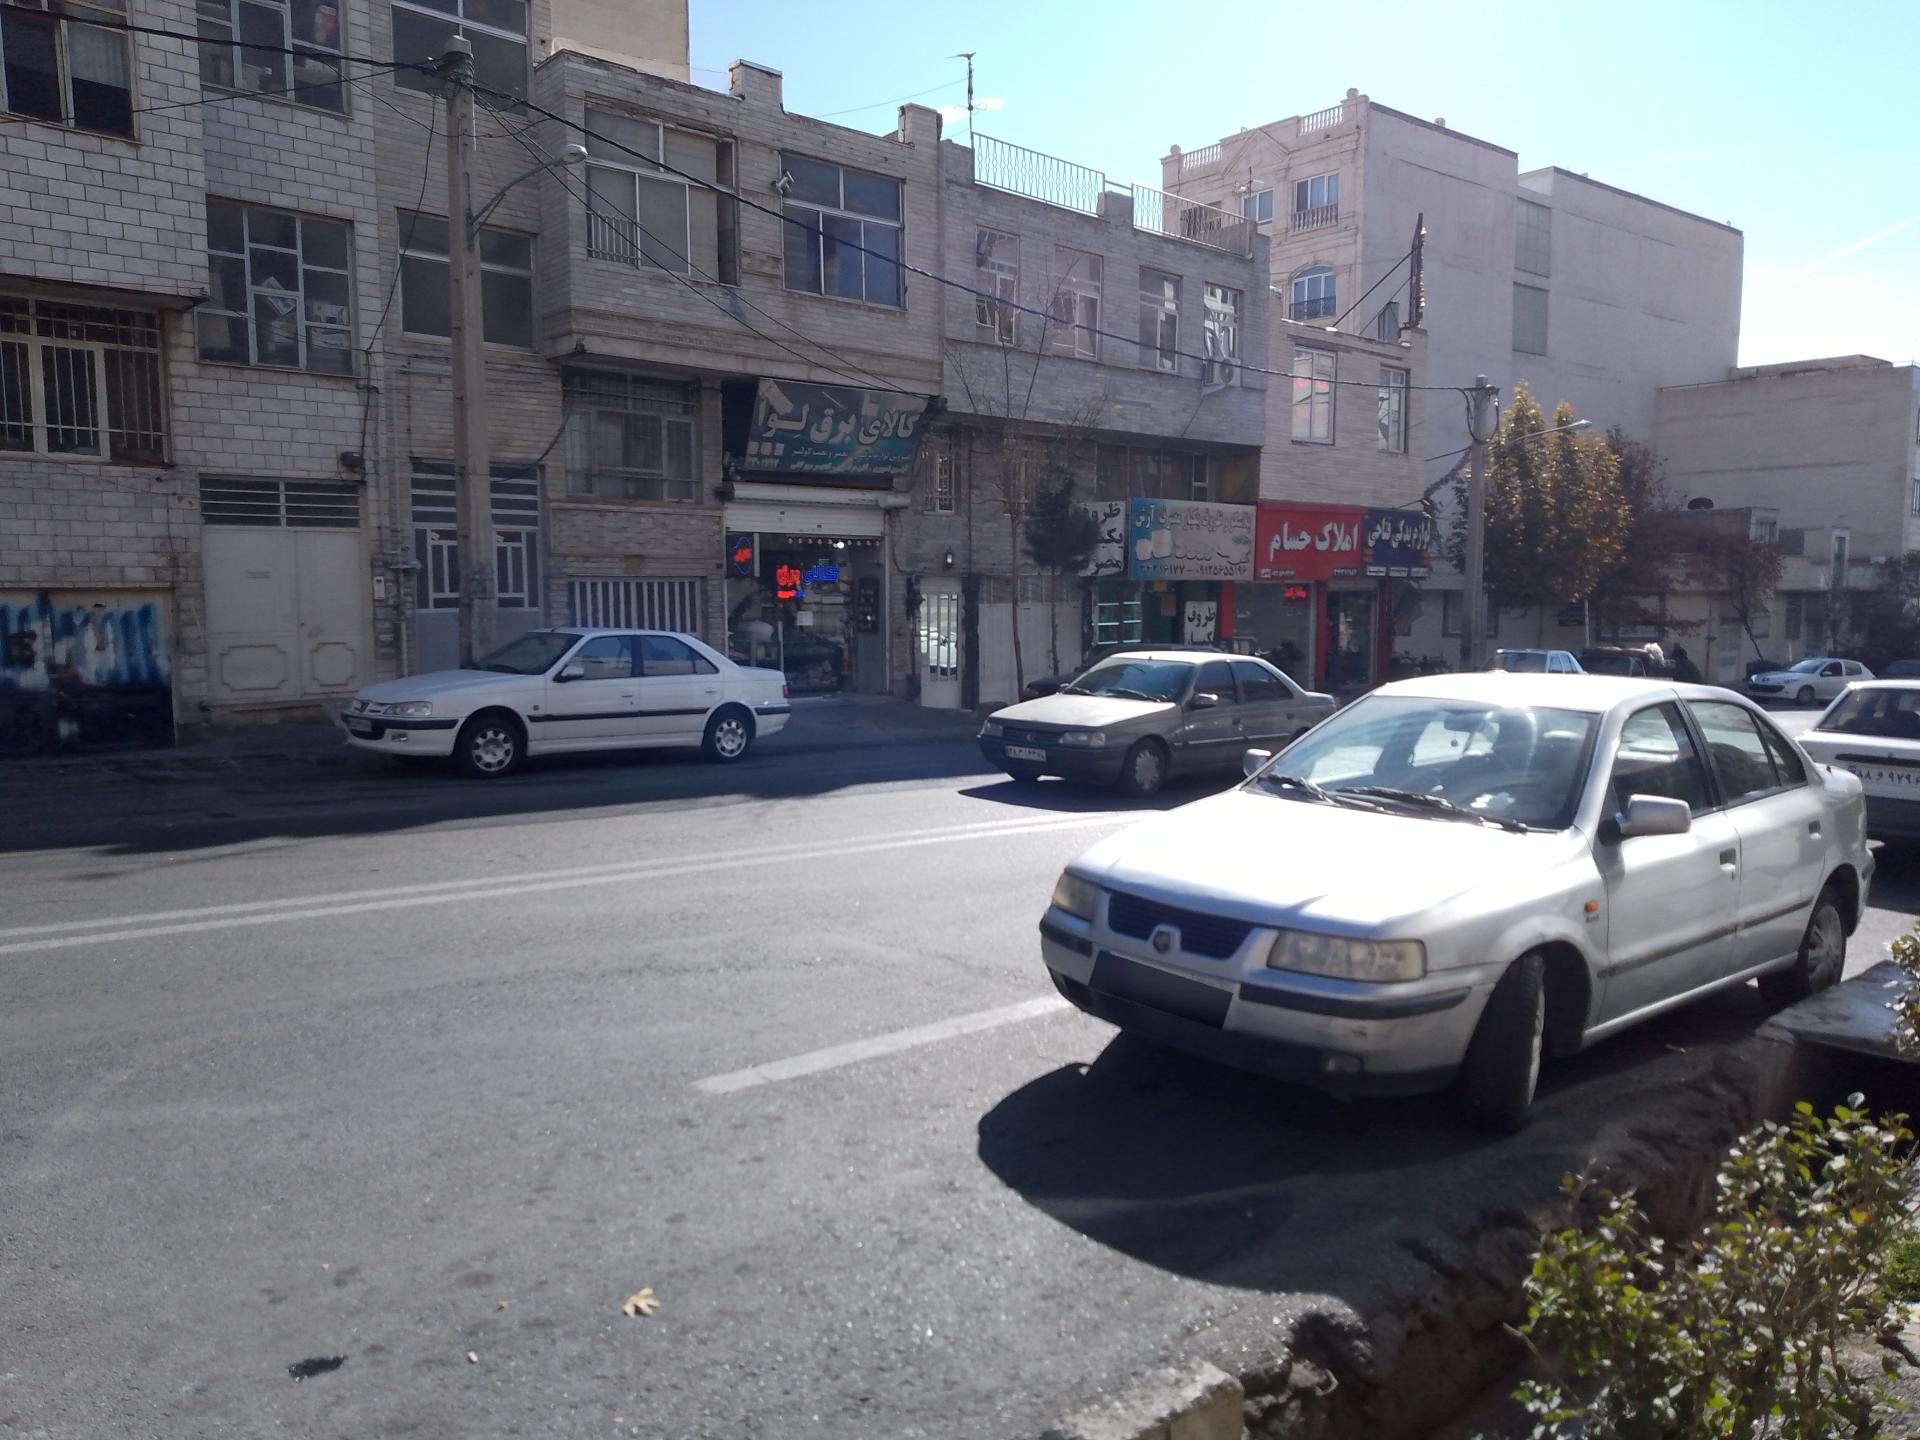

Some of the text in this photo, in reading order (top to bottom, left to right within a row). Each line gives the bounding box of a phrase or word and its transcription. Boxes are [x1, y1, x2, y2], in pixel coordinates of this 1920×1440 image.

[810, 407, 856, 444] برق
[858, 410, 921, 445] کالای
[1136, 504, 1155, 529] آرش
[1269, 522, 1312, 562] حسام
[1315, 522, 1359, 552] املاک
